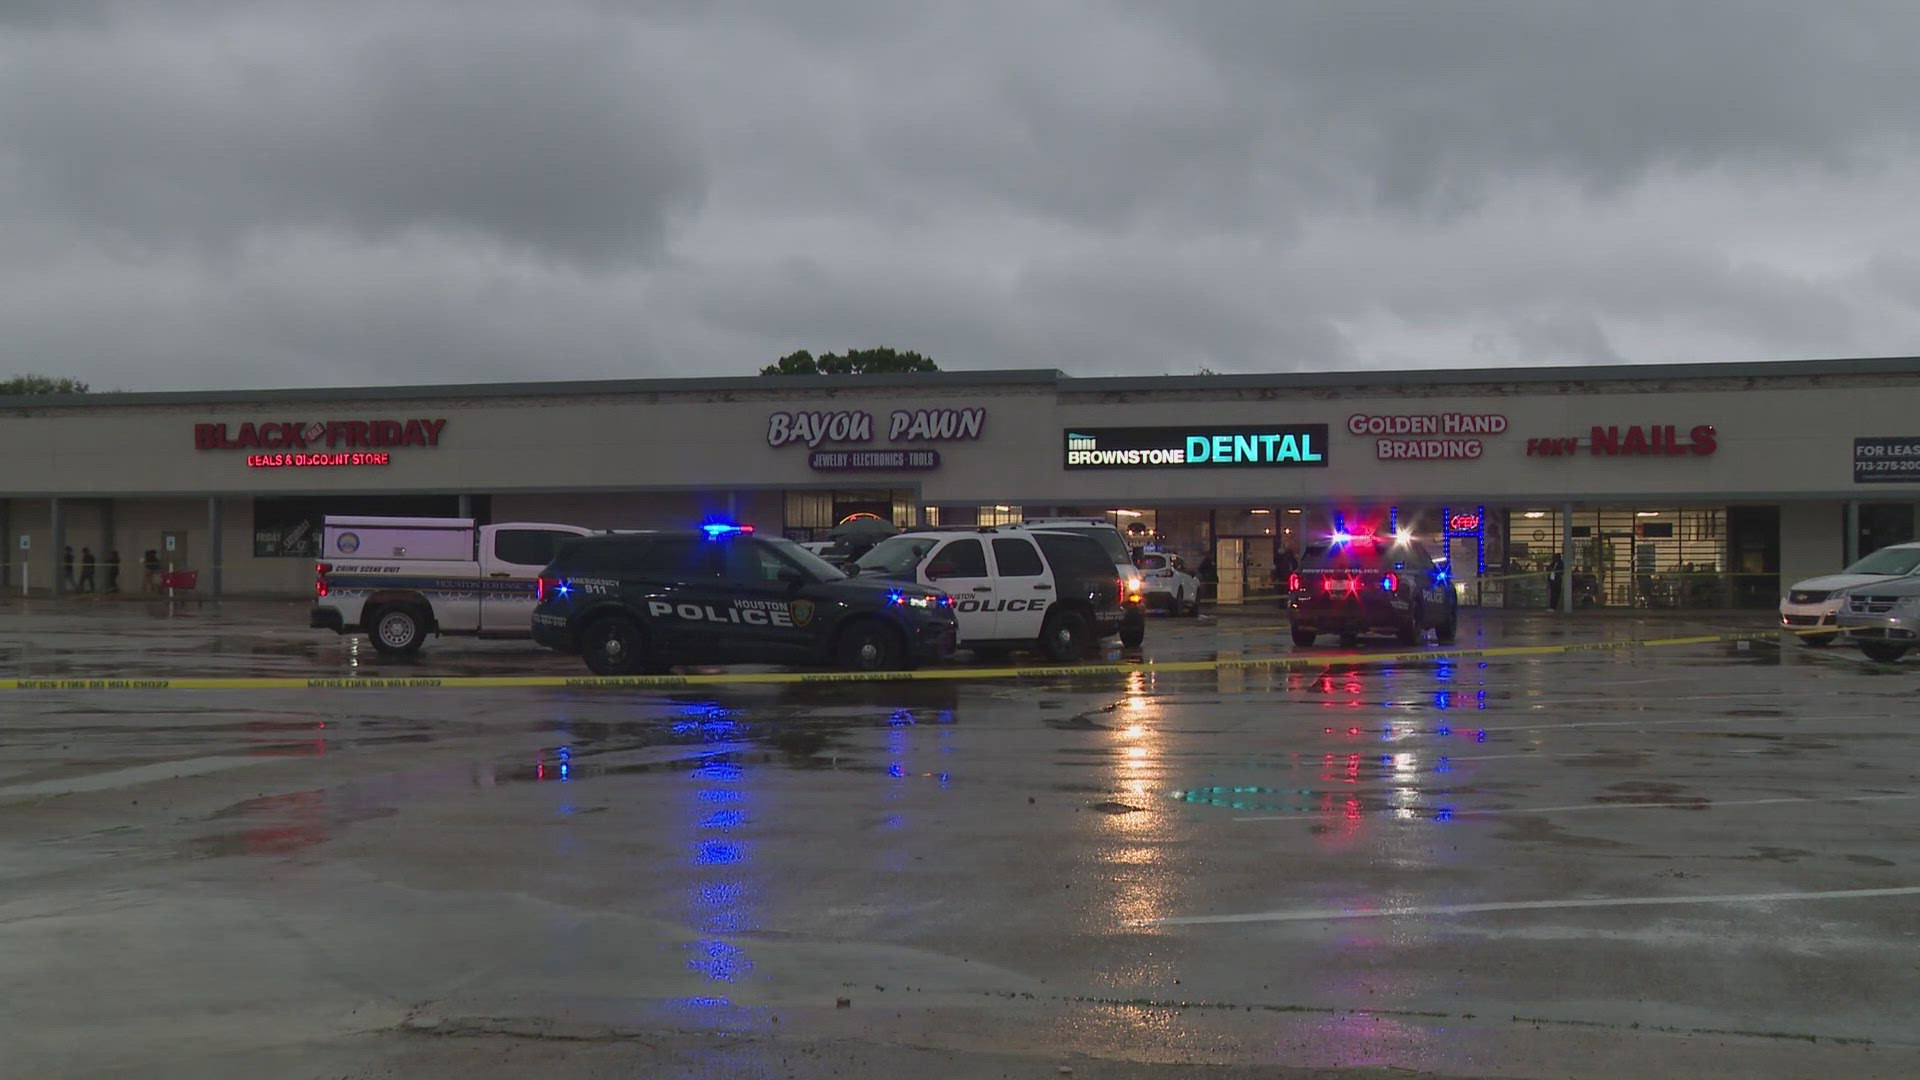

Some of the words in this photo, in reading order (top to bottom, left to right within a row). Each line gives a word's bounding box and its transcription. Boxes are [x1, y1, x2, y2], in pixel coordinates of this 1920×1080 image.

[768, 411, 873, 448] BAYOU
[889, 407, 985, 441] PAWN
[1349, 414, 1437, 434] GOLDEN
[1442, 413, 1507, 434] HAND
[195, 422, 306, 449] BLACK
[326, 419, 446, 448] FRIDAY
[1527, 437, 1578, 456] FOXY
[1591, 425, 1716, 456] NAILS
[1068, 449, 1185, 465] BROWNSTONE
[1186, 433, 1323, 464] DENTAL
[1377, 438, 1482, 459] BRAIDING
[1855, 445, 1885, 456] FOR
[1887, 445, 1920, 456] LEAS
[247, 454, 283, 467] DEALS
[284, 454, 293, 466] &
[295, 453, 350, 467] DISCOUNT
[351, 452, 390, 465] STORE
[813, 453, 848, 467] JEWELRY
[852, 452, 904, 467] ELECTRONICS
[908, 452, 934, 466] TOOLS
[256, 532, 282, 543] FRIDAY
[360, 565, 382, 573] SCENE
[584, 585, 606, 594] 911
[648, 601, 794, 628] POLICE
[734, 600, 788, 611] HOUSTON
